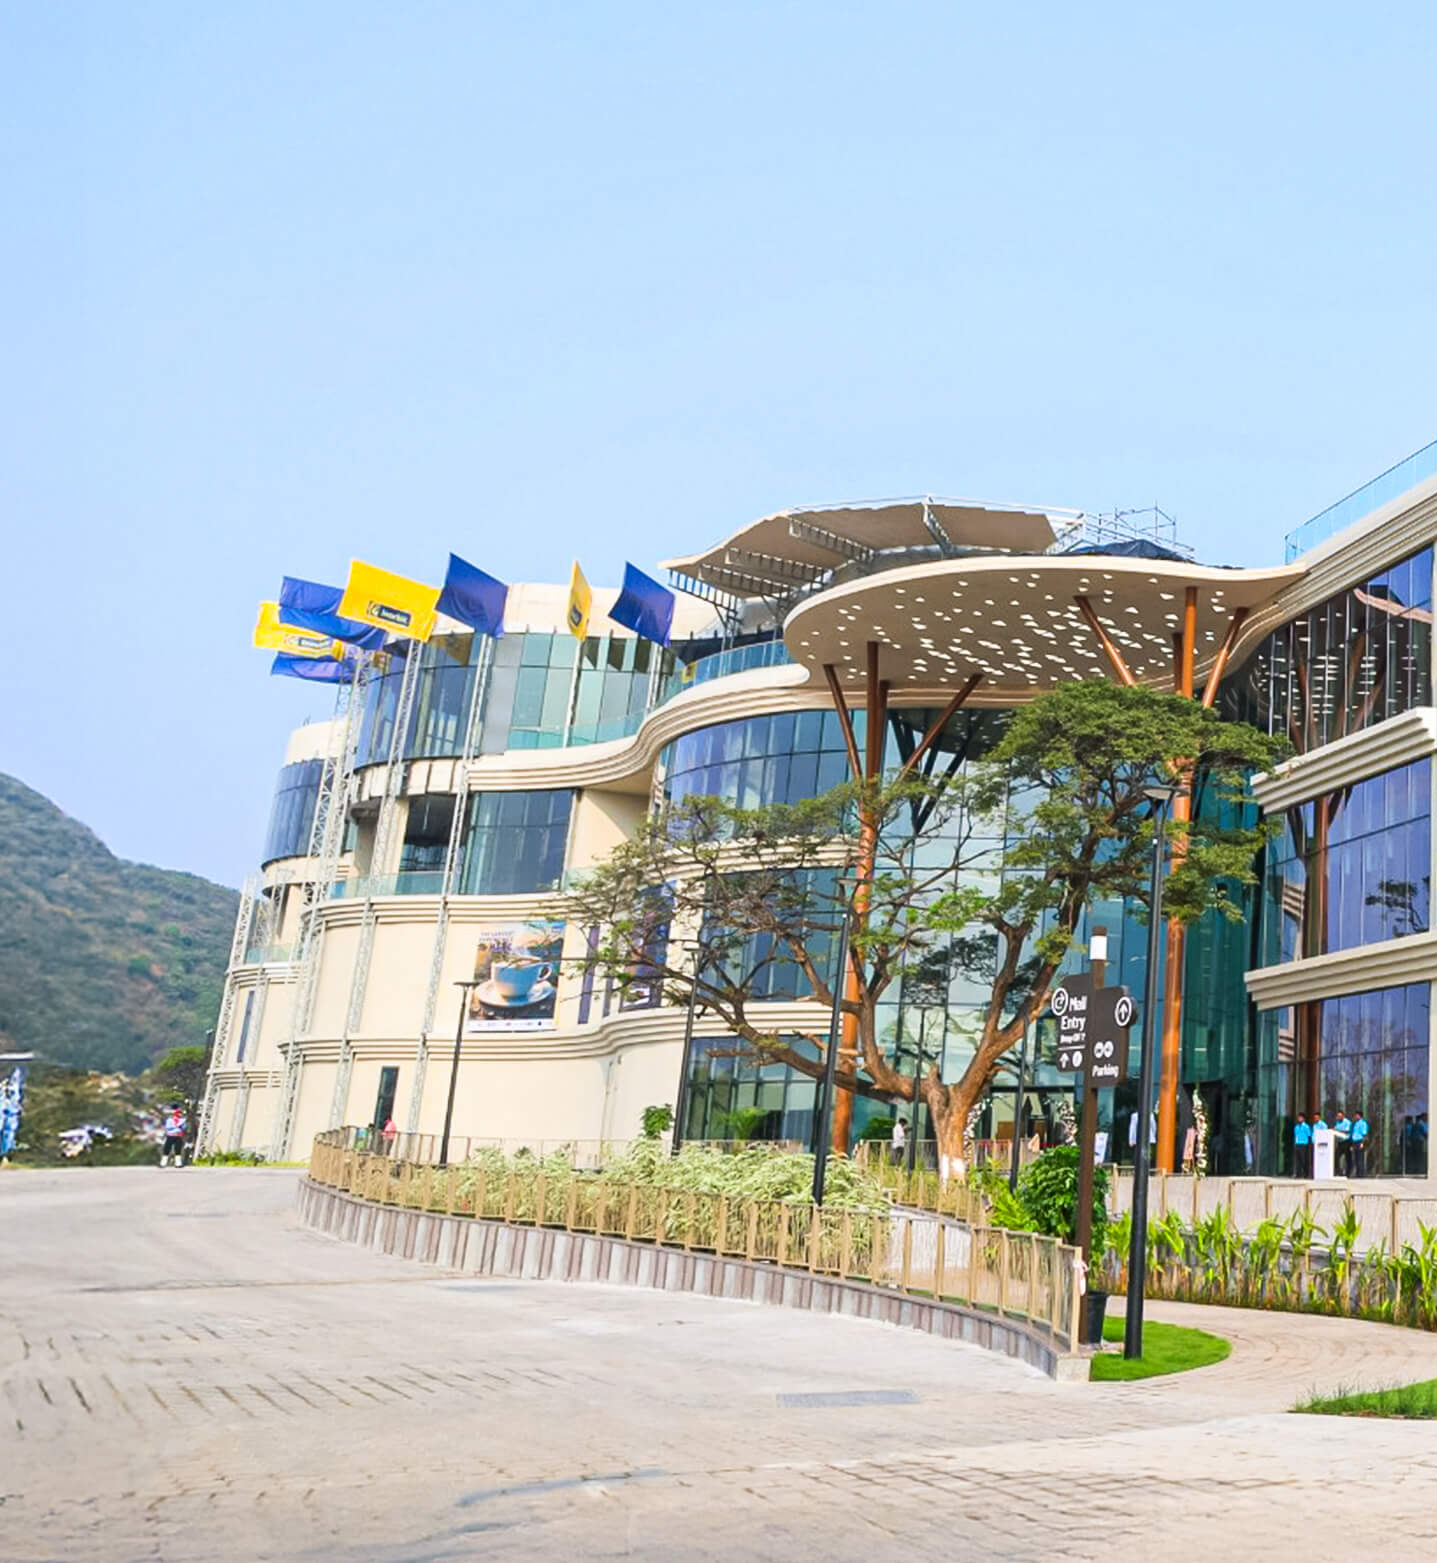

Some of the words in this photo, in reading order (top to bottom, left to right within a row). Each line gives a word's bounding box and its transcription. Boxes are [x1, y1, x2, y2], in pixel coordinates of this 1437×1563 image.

[1069, 995, 1088, 1012] Mall
[1060, 1015, 1086, 1031] Entry
[1092, 1064, 1119, 1078] Parking
